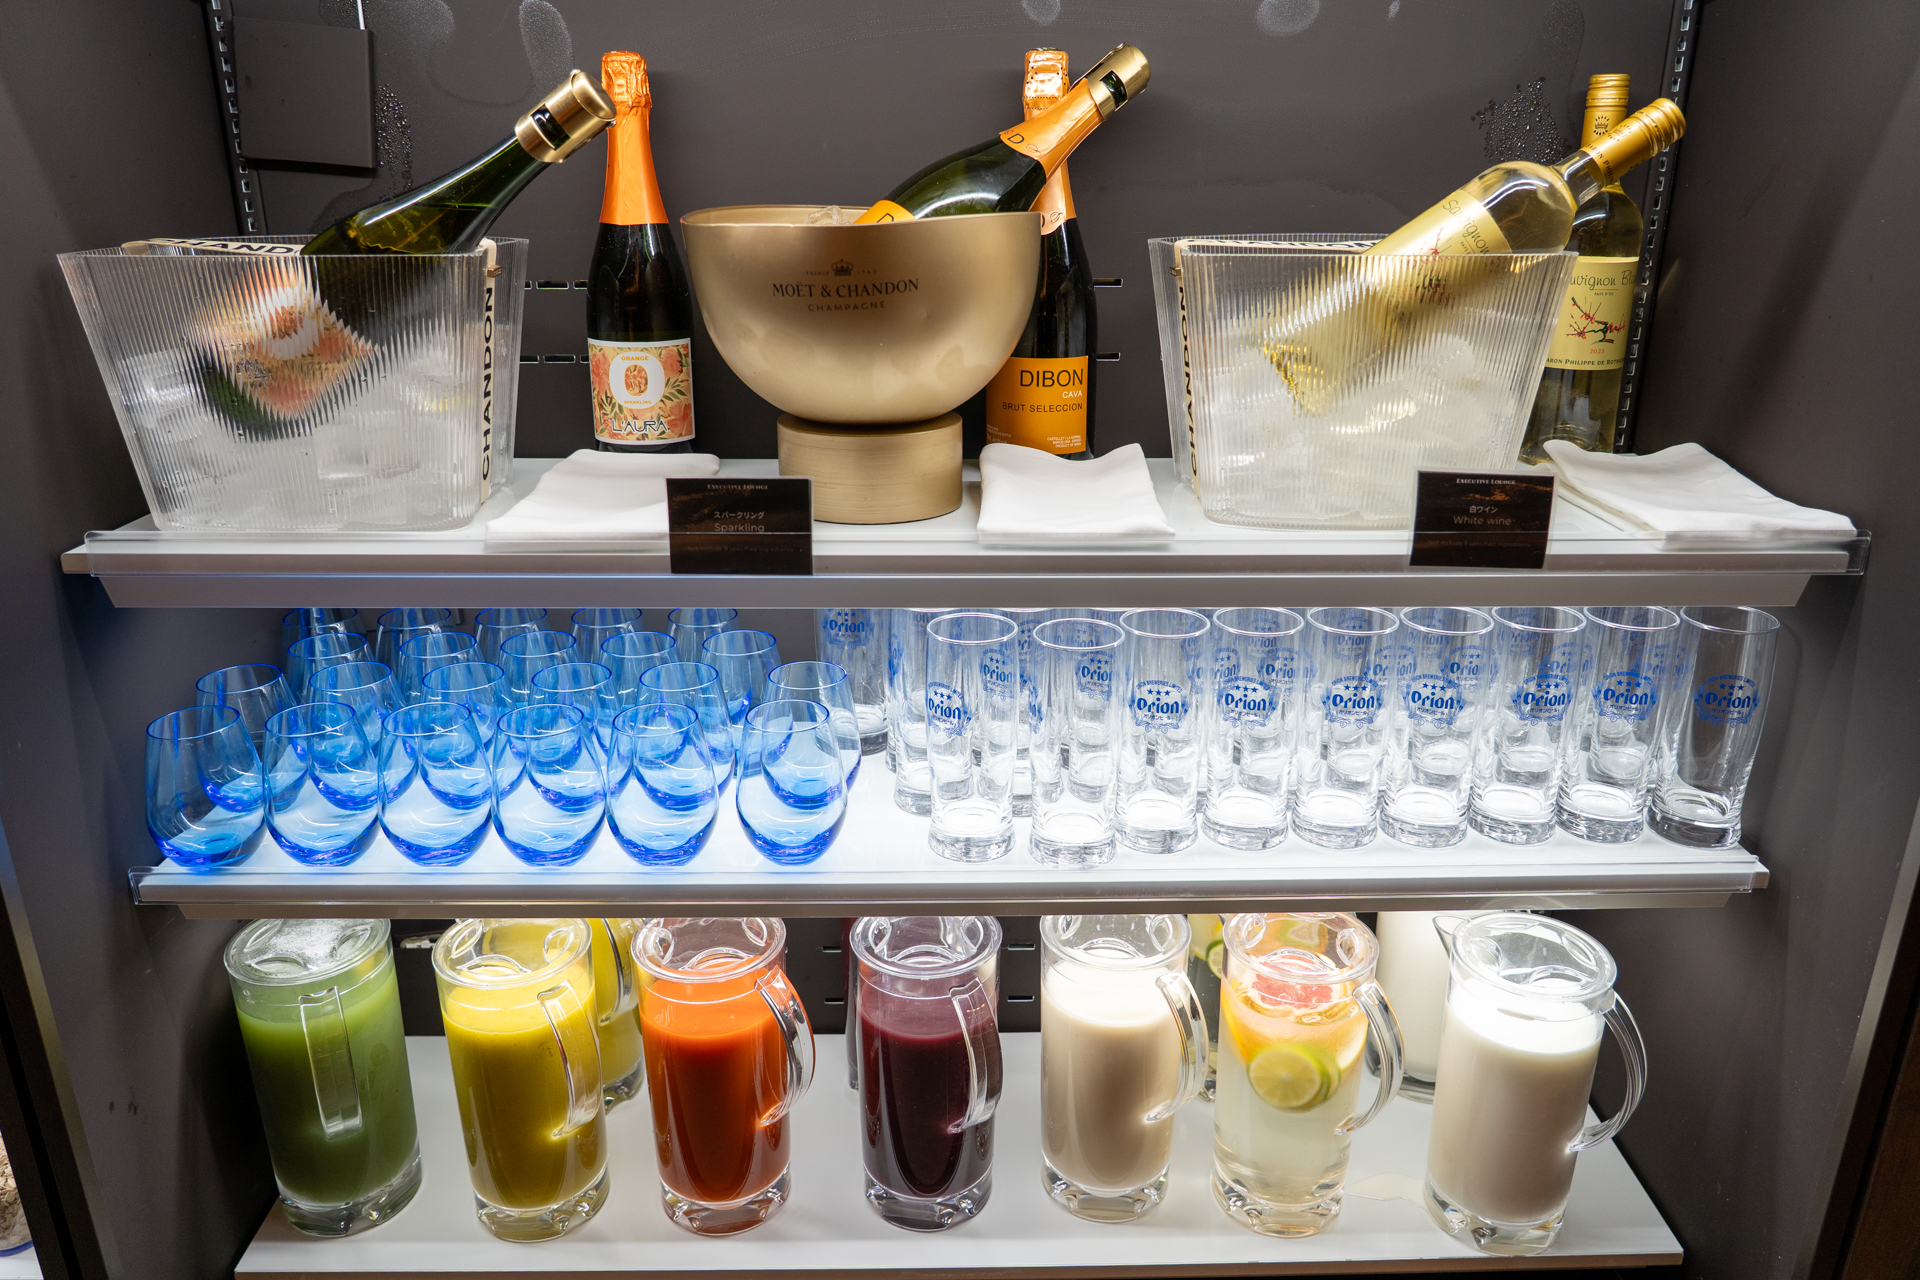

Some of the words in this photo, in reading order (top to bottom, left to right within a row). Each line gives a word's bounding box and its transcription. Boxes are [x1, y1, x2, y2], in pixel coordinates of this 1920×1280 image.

[773, 282, 815, 297] MOËT
[820, 284, 832, 298] &
[836, 278, 919, 298] CHANDON
[1570, 275, 1616, 290] uvignon
[808, 301, 885, 312] CHAMPAGNE
[482, 287, 493, 480] CHANDON
[1020, 368, 1083, 387] DIBON
[1179, 286, 1197, 476] CHANDON
[1062, 390, 1082, 398] CAVA
[1002, 402, 1026, 412] BRUT
[1030, 403, 1082, 412] SELECCION
[1469, 506, 1498, 514] 白ワイン
[714, 523, 765, 533] Sparkling
[1453, 516, 1484, 525] White
[1487, 517, 1512, 526] wine
[829, 618, 864, 632] Orion
[1225, 693, 1266, 711] Orion
[1332, 692, 1374, 709] Orion
[1411, 690, 1454, 710] Orion
[1524, 690, 1566, 706] Orion
[1604, 688, 1648, 705] Orion
[1705, 692, 1751, 708] Orion
[929, 698, 961, 720] Orion
[1137, 697, 1180, 714] Orion
